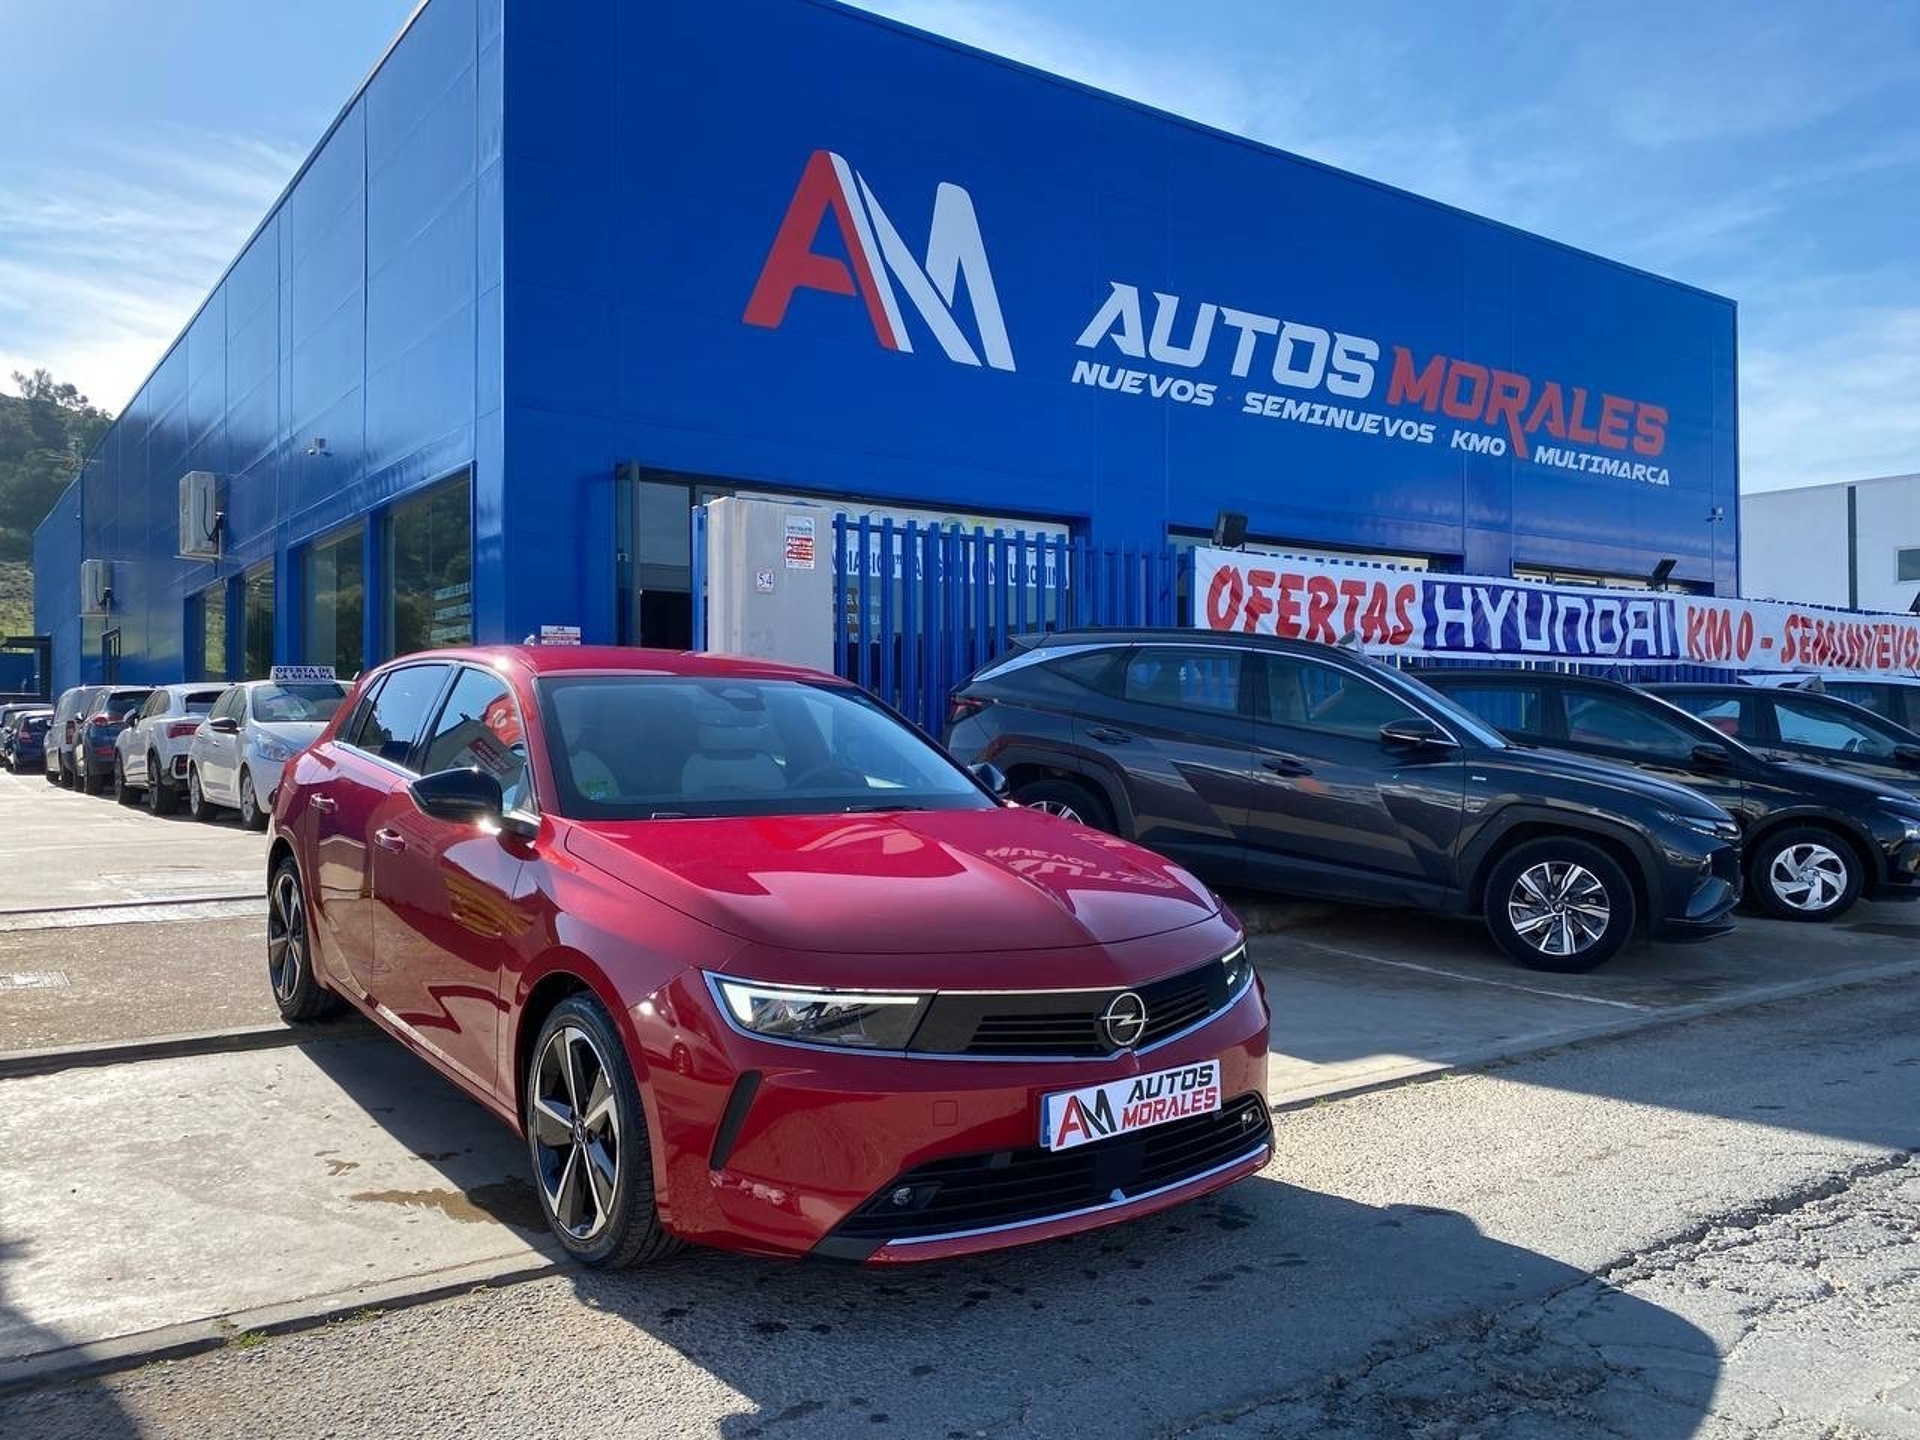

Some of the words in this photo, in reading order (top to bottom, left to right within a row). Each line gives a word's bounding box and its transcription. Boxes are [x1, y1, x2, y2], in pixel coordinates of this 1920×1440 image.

[742, 149, 1016, 372] AM
[1071, 360, 1218, 407] NUEVOS
[1242, 391, 1437, 444] SEMINUEVOS
[1534, 445, 1670, 486] MULTIMARCA
[1075, 281, 1380, 399] AUTOS
[1386, 345, 1669, 459] MORALES
[1206, 564, 1416, 646] OFERTAS
[1435, 585, 1672, 657] HYUNDAI
[1780, 613, 1920, 670] SEMINUEVO
[1055, 1088, 1117, 1147] AM
[1121, 1086, 1218, 1131] MORALES
[1127, 1064, 1214, 1105] AUTOS
